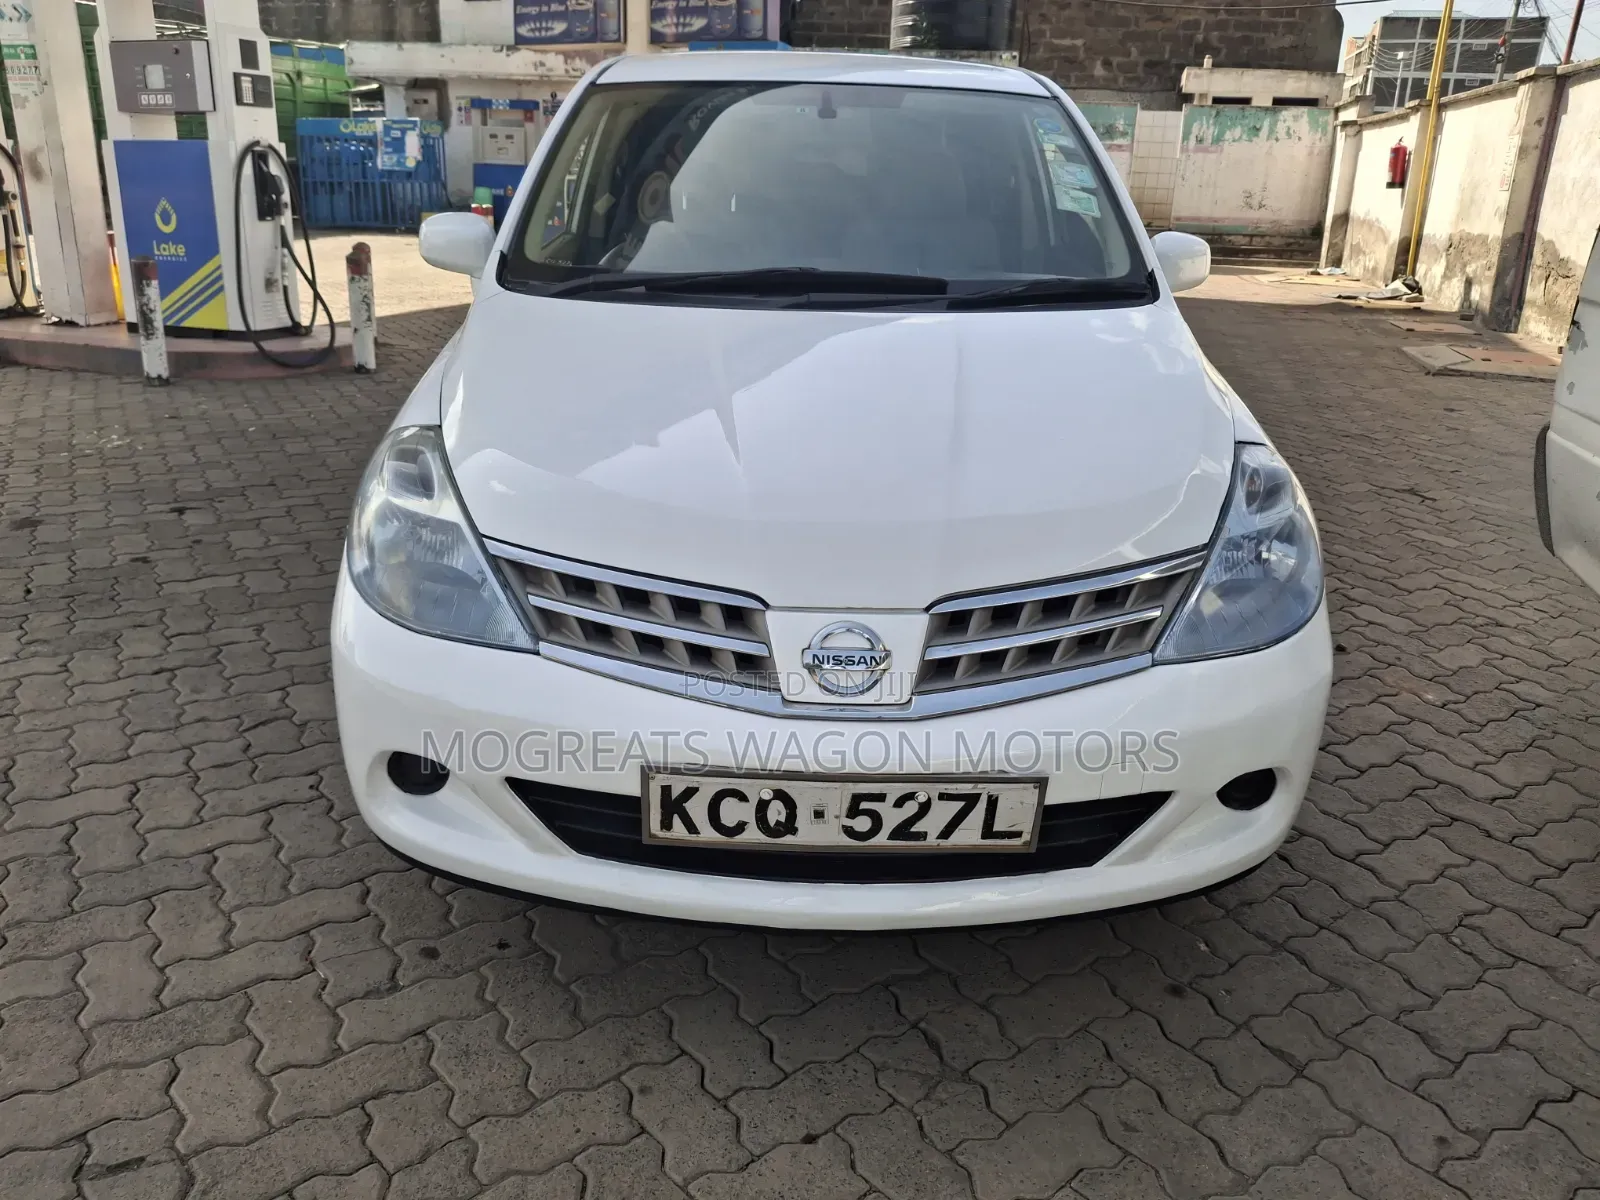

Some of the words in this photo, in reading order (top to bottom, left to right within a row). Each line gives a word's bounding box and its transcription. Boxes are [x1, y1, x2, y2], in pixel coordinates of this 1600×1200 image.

[153, 240, 186, 256] Lake
[812, 653, 884, 667] NISSAN
[660, 784, 799, 839] KCQ
[842, 791, 1024, 843] 527L
